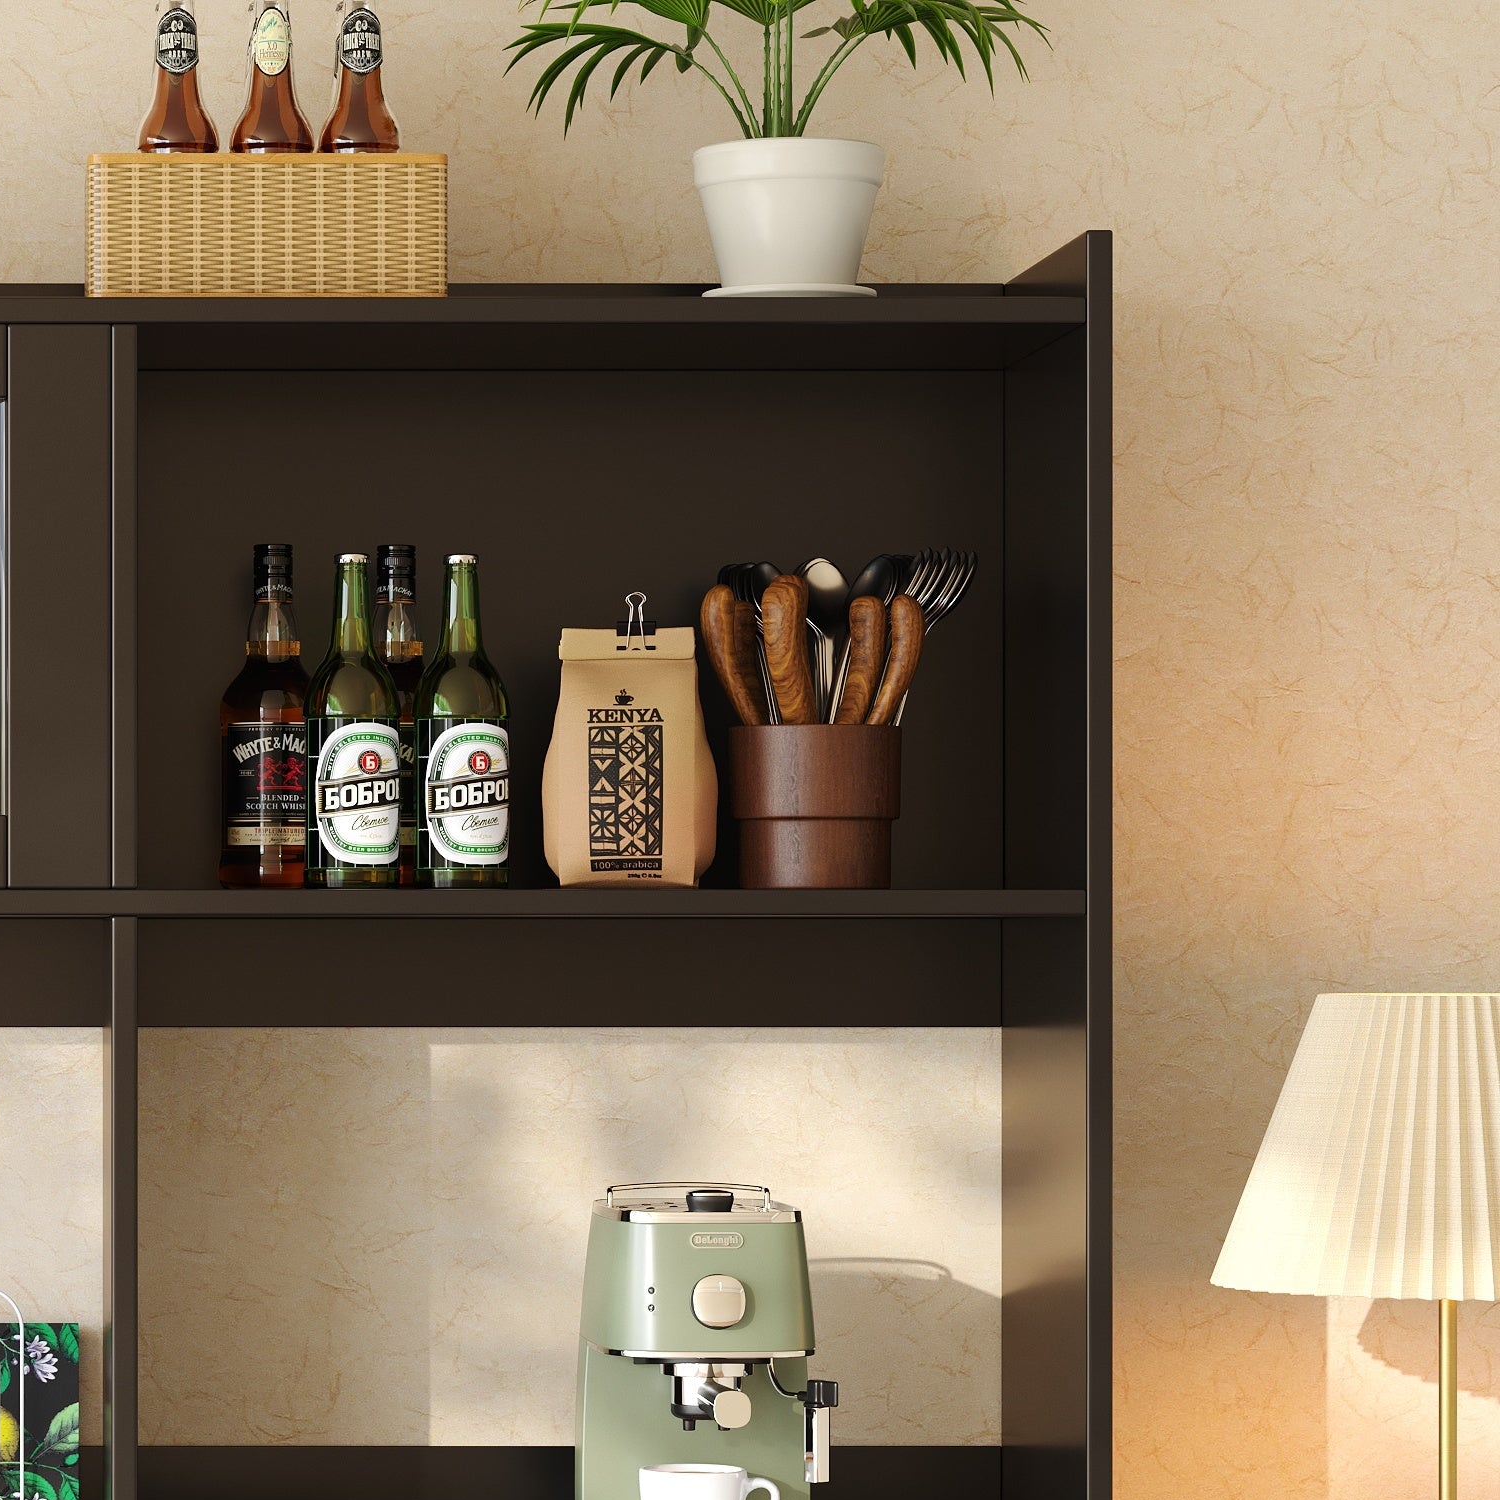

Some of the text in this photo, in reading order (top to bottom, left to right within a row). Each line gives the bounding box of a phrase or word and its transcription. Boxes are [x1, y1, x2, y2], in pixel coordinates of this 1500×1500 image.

[587, 708, 664, 723] KENYA
[233, 733, 306, 763] WHYTE & MAC
[594, 860, 659, 869] 100% arabica
